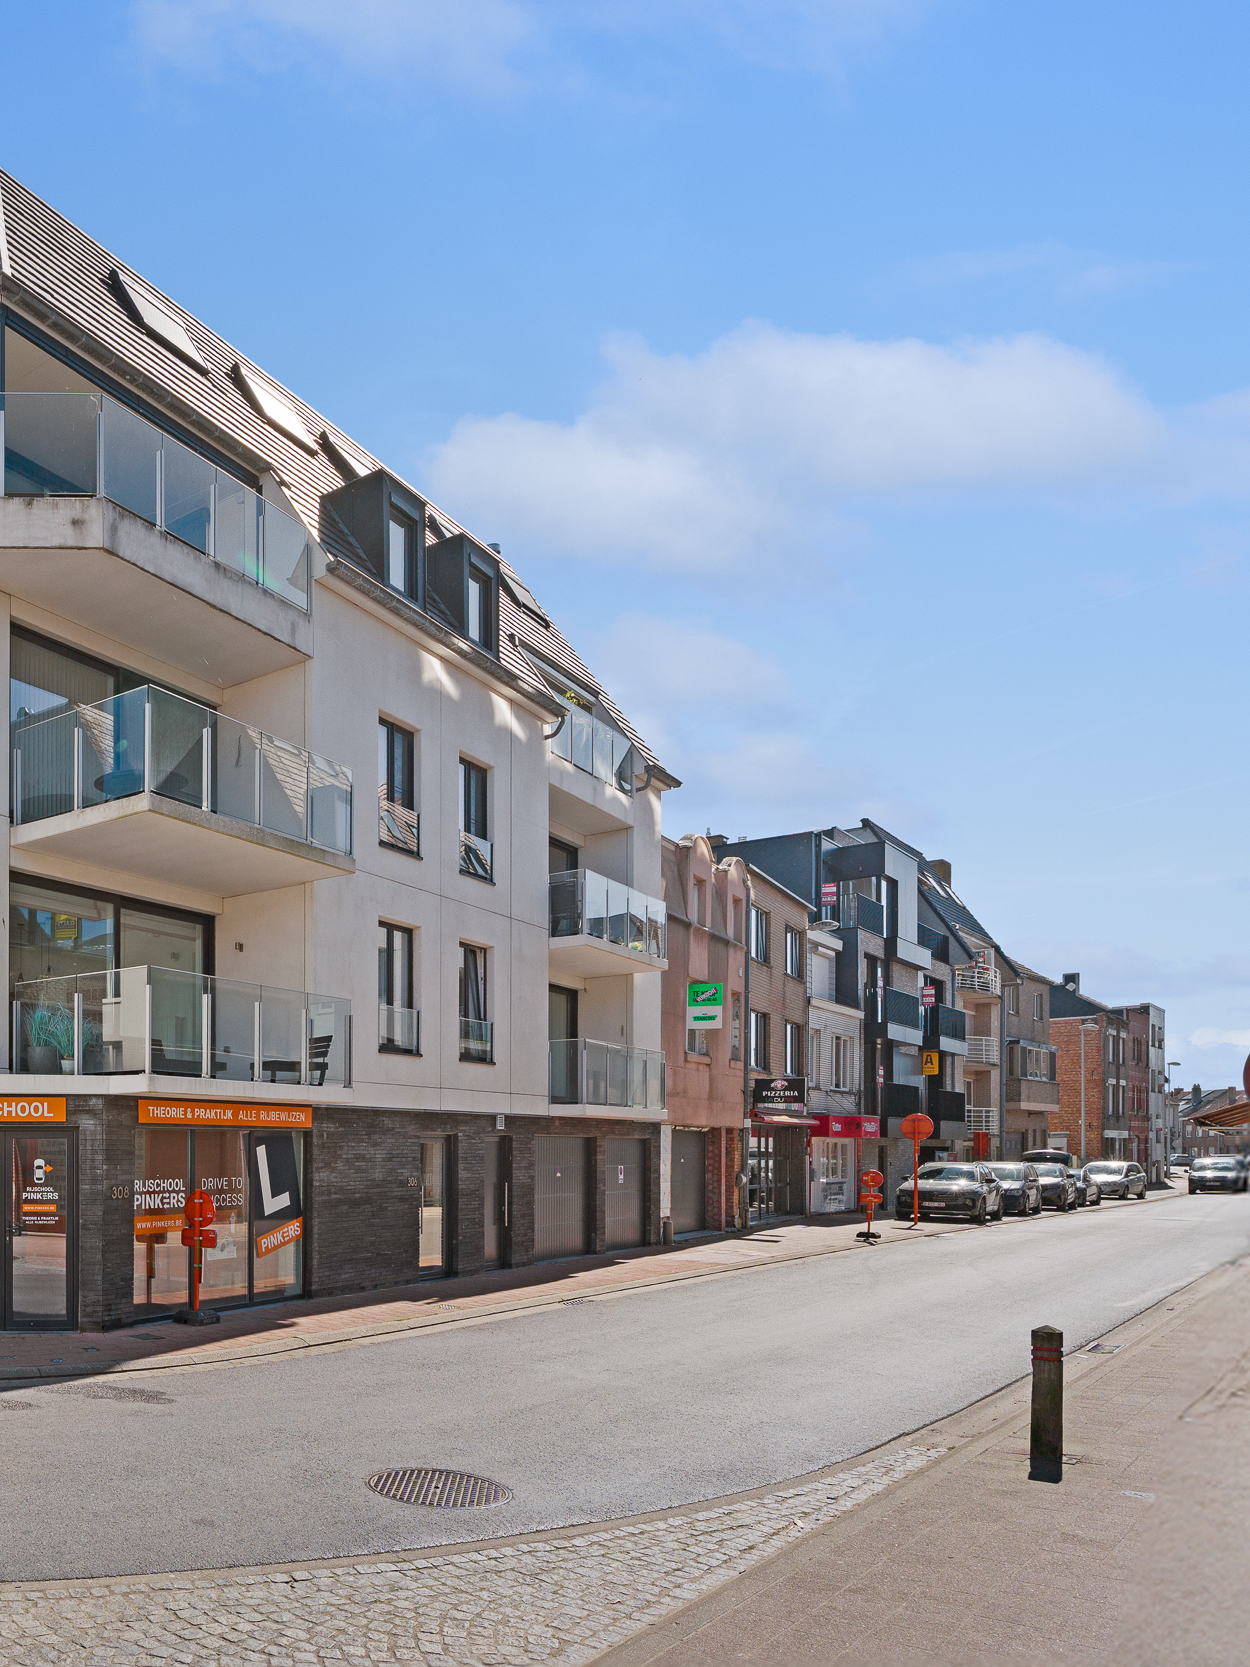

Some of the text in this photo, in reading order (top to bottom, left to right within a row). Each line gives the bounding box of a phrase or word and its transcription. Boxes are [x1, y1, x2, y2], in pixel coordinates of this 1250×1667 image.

[148, 1106, 306, 1122] THEORIE & PRAKTIJK ALLE RIJBEWIJZEN
[134, 1178, 185, 1192] RIJSCHOOL
[201, 1177, 243, 1190] DRIVE TO
[256, 1144, 291, 1217] L
[407, 1177, 418, 1187] 306
[22, 1192, 59, 1200] PINKERS
[111, 1186, 130, 1199] 308
[134, 1192, 185, 1209] PINKERS
[136, 1219, 183, 1229] WWW.PINKERS.BE
[261, 1222, 301, 1252] PINKERS
